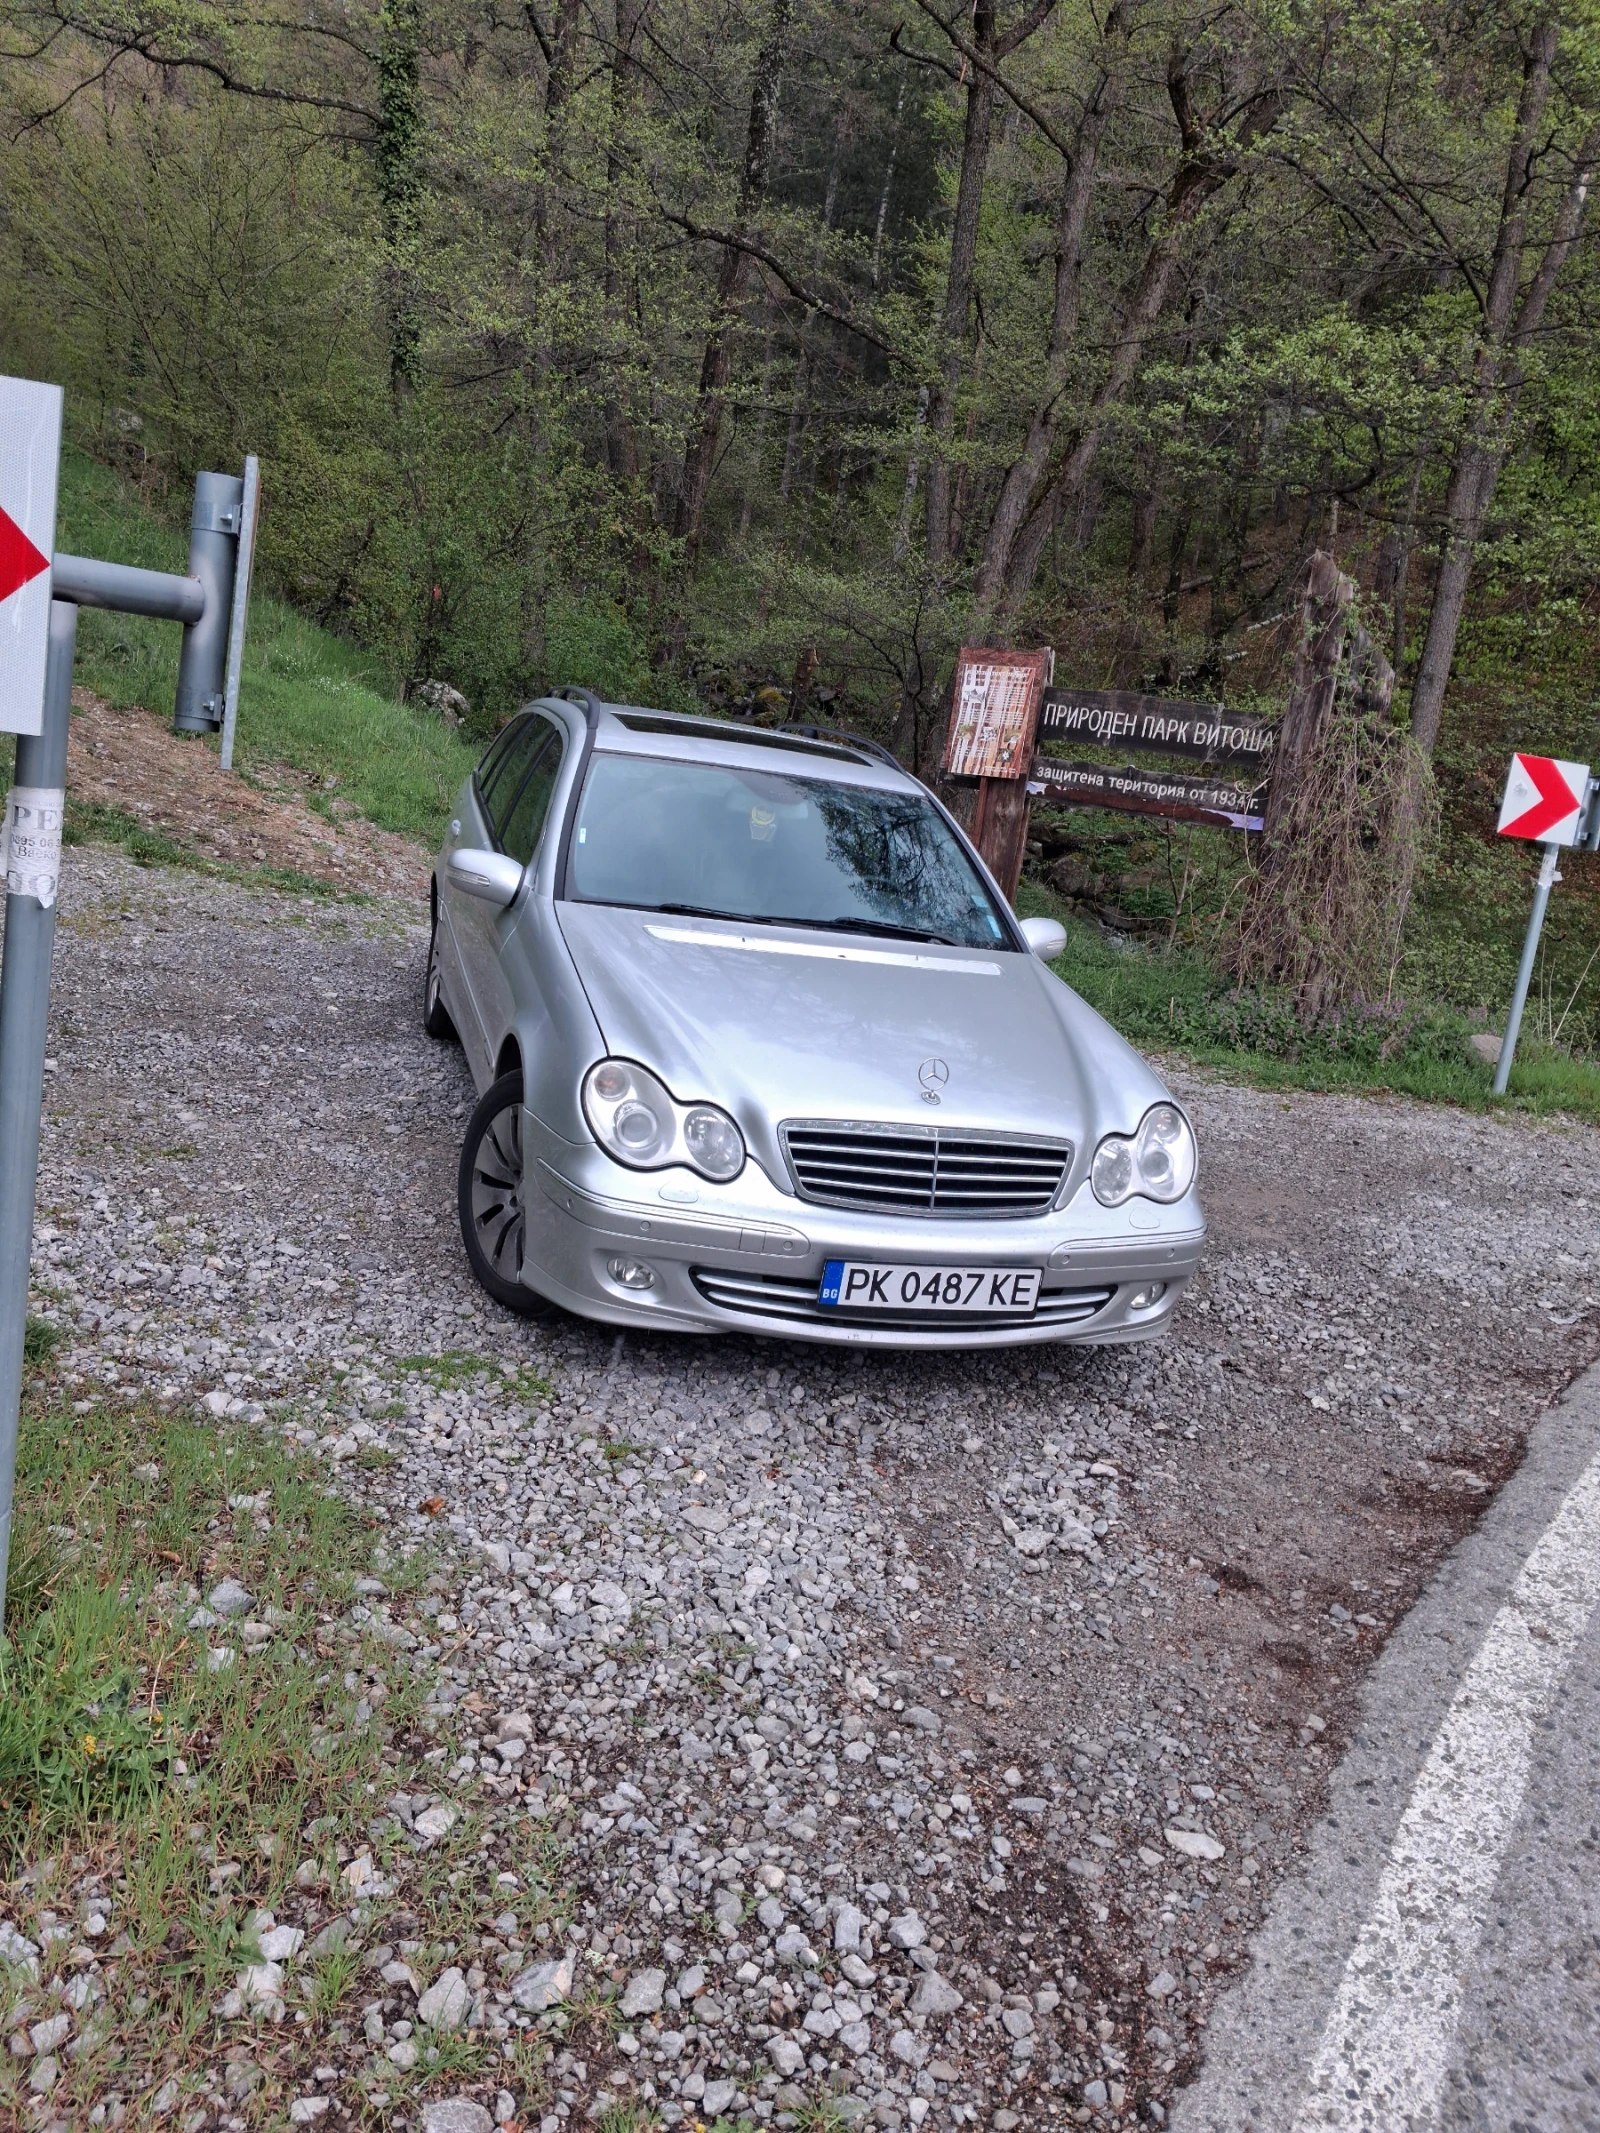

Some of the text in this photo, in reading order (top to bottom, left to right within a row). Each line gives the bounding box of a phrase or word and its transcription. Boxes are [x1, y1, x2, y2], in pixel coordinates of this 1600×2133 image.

[1044, 703, 1138, 739] ПРИРОДЕН
[1141, 716, 1190, 744] ПАРК
[1193, 722, 1274, 754] ВИТОША
[1036, 766, 1104, 787] защитена
[1108, 777, 1186, 800] територия
[1189, 788, 1208, 801] от
[822, 1288, 838, 1299] BG
[844, 1268, 1035, 1306] PK 0487 KE
